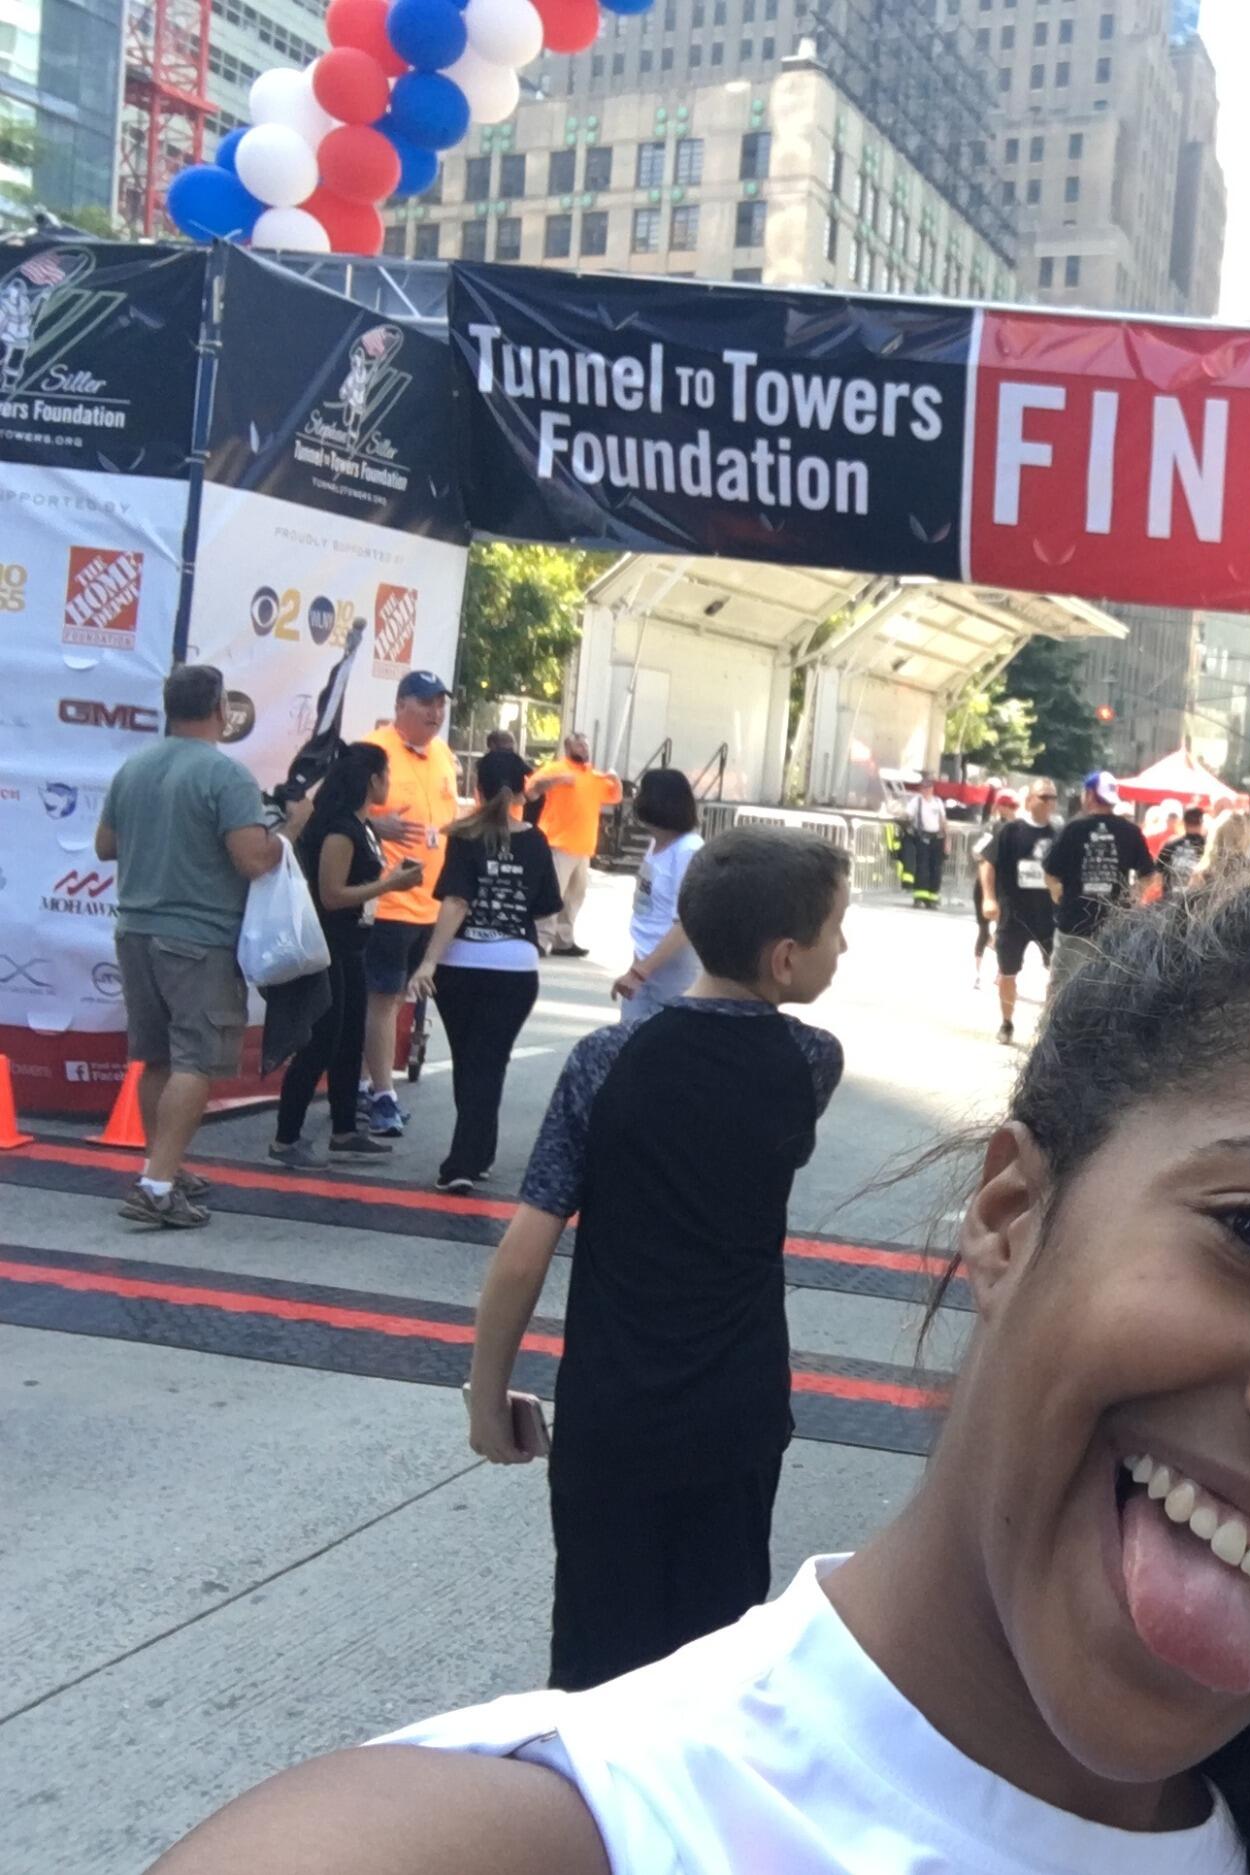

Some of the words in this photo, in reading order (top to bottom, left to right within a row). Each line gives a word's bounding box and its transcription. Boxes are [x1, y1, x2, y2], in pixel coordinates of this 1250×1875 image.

[40, 363, 107, 394] Siller
[468, 323, 663, 413] Tunnel
[676, 366, 715, 408] TO
[722, 350, 943, 442] Towers
[0, 401, 29, 420] ers
[33, 399, 126, 428] Foundation
[360, 460, 408, 491] Foundation
[537, 411, 869, 516] Foundation
[74, 555, 106, 587] THE
[66, 552, 142, 626] HOME
[93, 581, 140, 628] DEPOT
[275, 587, 301, 642] 2
[58, 698, 159, 733] GMC
[40, 896, 119, 918] MOHAWK
